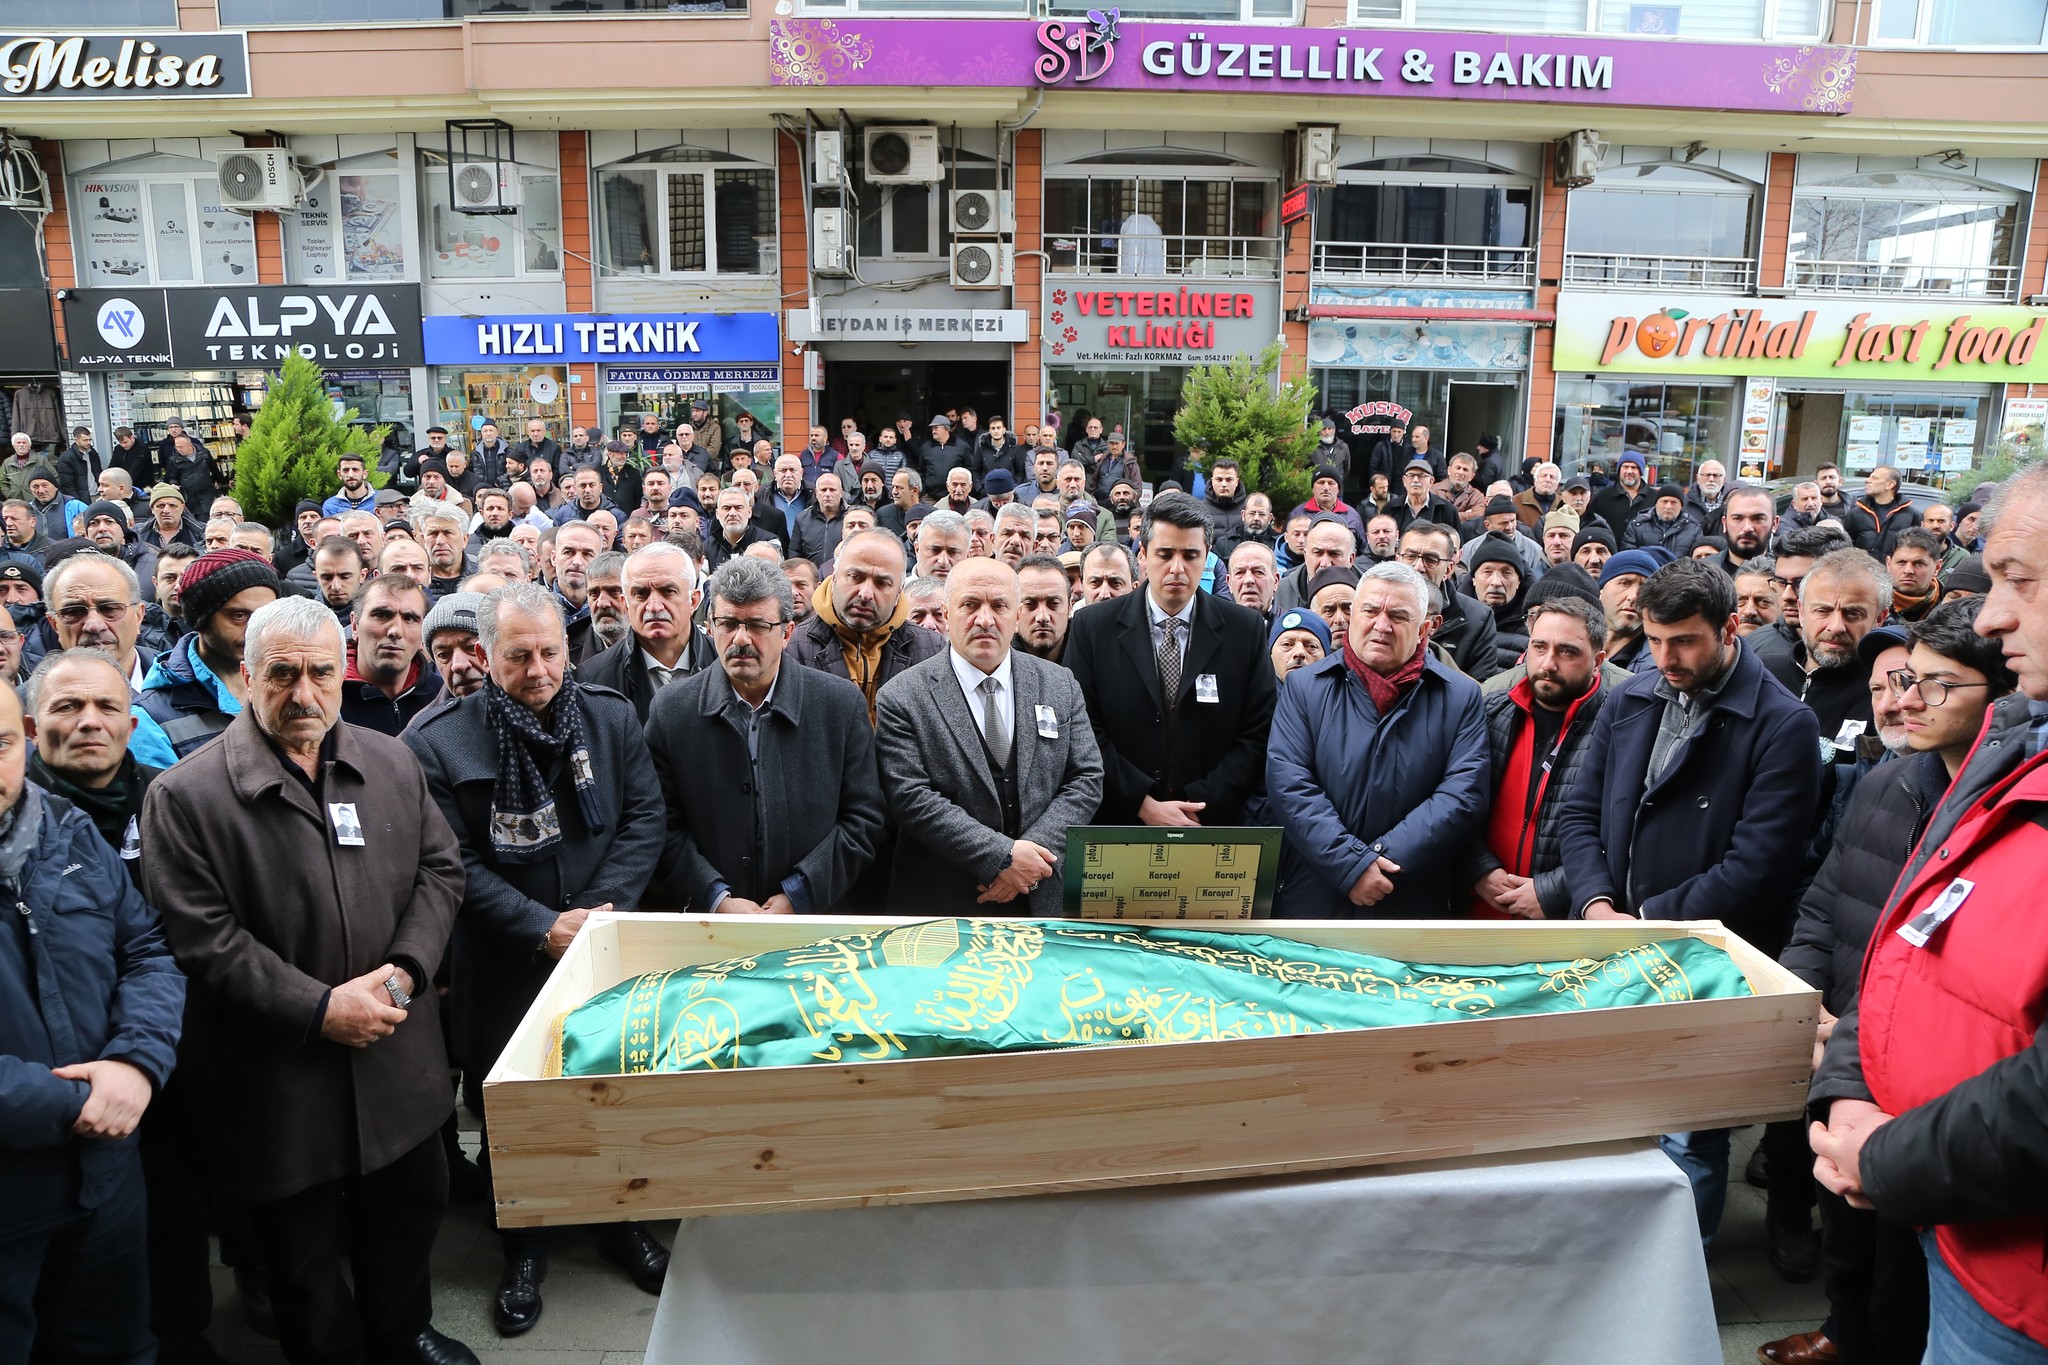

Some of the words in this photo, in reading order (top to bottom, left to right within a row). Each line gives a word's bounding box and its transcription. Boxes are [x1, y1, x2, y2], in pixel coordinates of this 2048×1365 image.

[0, 37, 220, 94] Melisa
[1142, 33, 1384, 82] GÜZELLİK
[1401, 48, 1434, 83] &
[1454, 50, 1614, 89] BAKIM
[267, 153, 277, 185] BOSCH
[84, 184, 138, 192] HIKVISION
[300, 211, 329, 219] TEKNİK
[301, 219, 328, 227] SERVİS
[1074, 286, 1255, 318] VETERİNER
[204, 294, 397, 338] ALPYA
[821, 317, 888, 332] EYDAN
[895, 315, 912, 335] İŞ
[919, 316, 1004, 332] MERKEZİ
[477, 323, 564, 355] HIZLI
[1108, 320, 1215, 349] KLİNİĞİ
[1832, 312, 1932, 368] fast
[1931, 315, 2048, 371] food
[79, 355, 124, 364] ALPYA
[1077, 352, 1092, 360] Vet.
[1093, 352, 1124, 360] Hekimi:
[1125, 352, 1143, 360] Fazlı
[1144, 353, 1183, 361] KORKMAZ
[610, 371, 660, 380] FATURA
[663, 369, 710, 380] ÖDEME
[713, 368, 774, 379] MERKEZİ
[1345, 401, 1413, 425] KUSPA
[1351, 425, 1407, 435] ÇAYE
[1149, 871, 1181, 881] Karayel
[1215, 870, 1247, 881] Karayel
[1082, 889, 1107, 899] arayel
[1139, 889, 1171, 899] Karayel
[1202, 888, 1234, 899] Karayel
